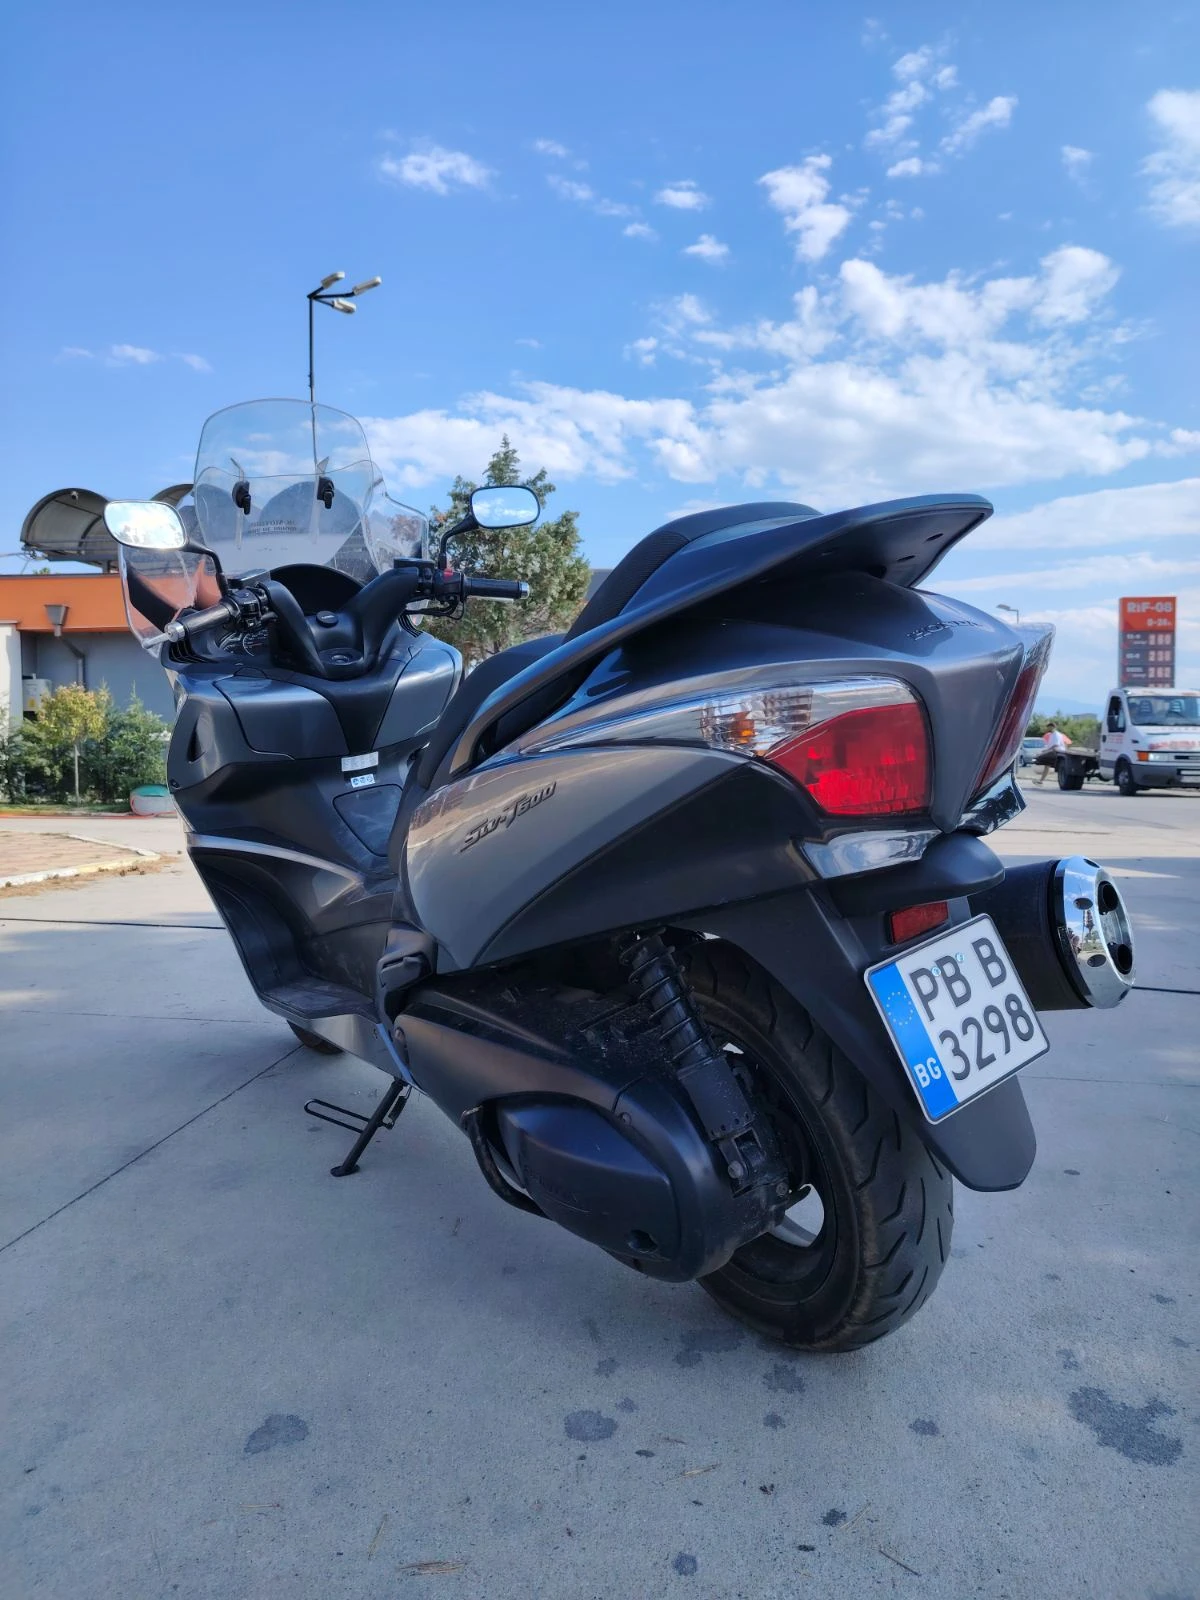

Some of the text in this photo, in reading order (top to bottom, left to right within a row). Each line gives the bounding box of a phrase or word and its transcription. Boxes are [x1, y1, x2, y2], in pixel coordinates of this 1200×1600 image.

[909, 937, 1007, 1022] PB B
[914, 1057, 942, 1088] BG
[939, 993, 1035, 1081] 3298
